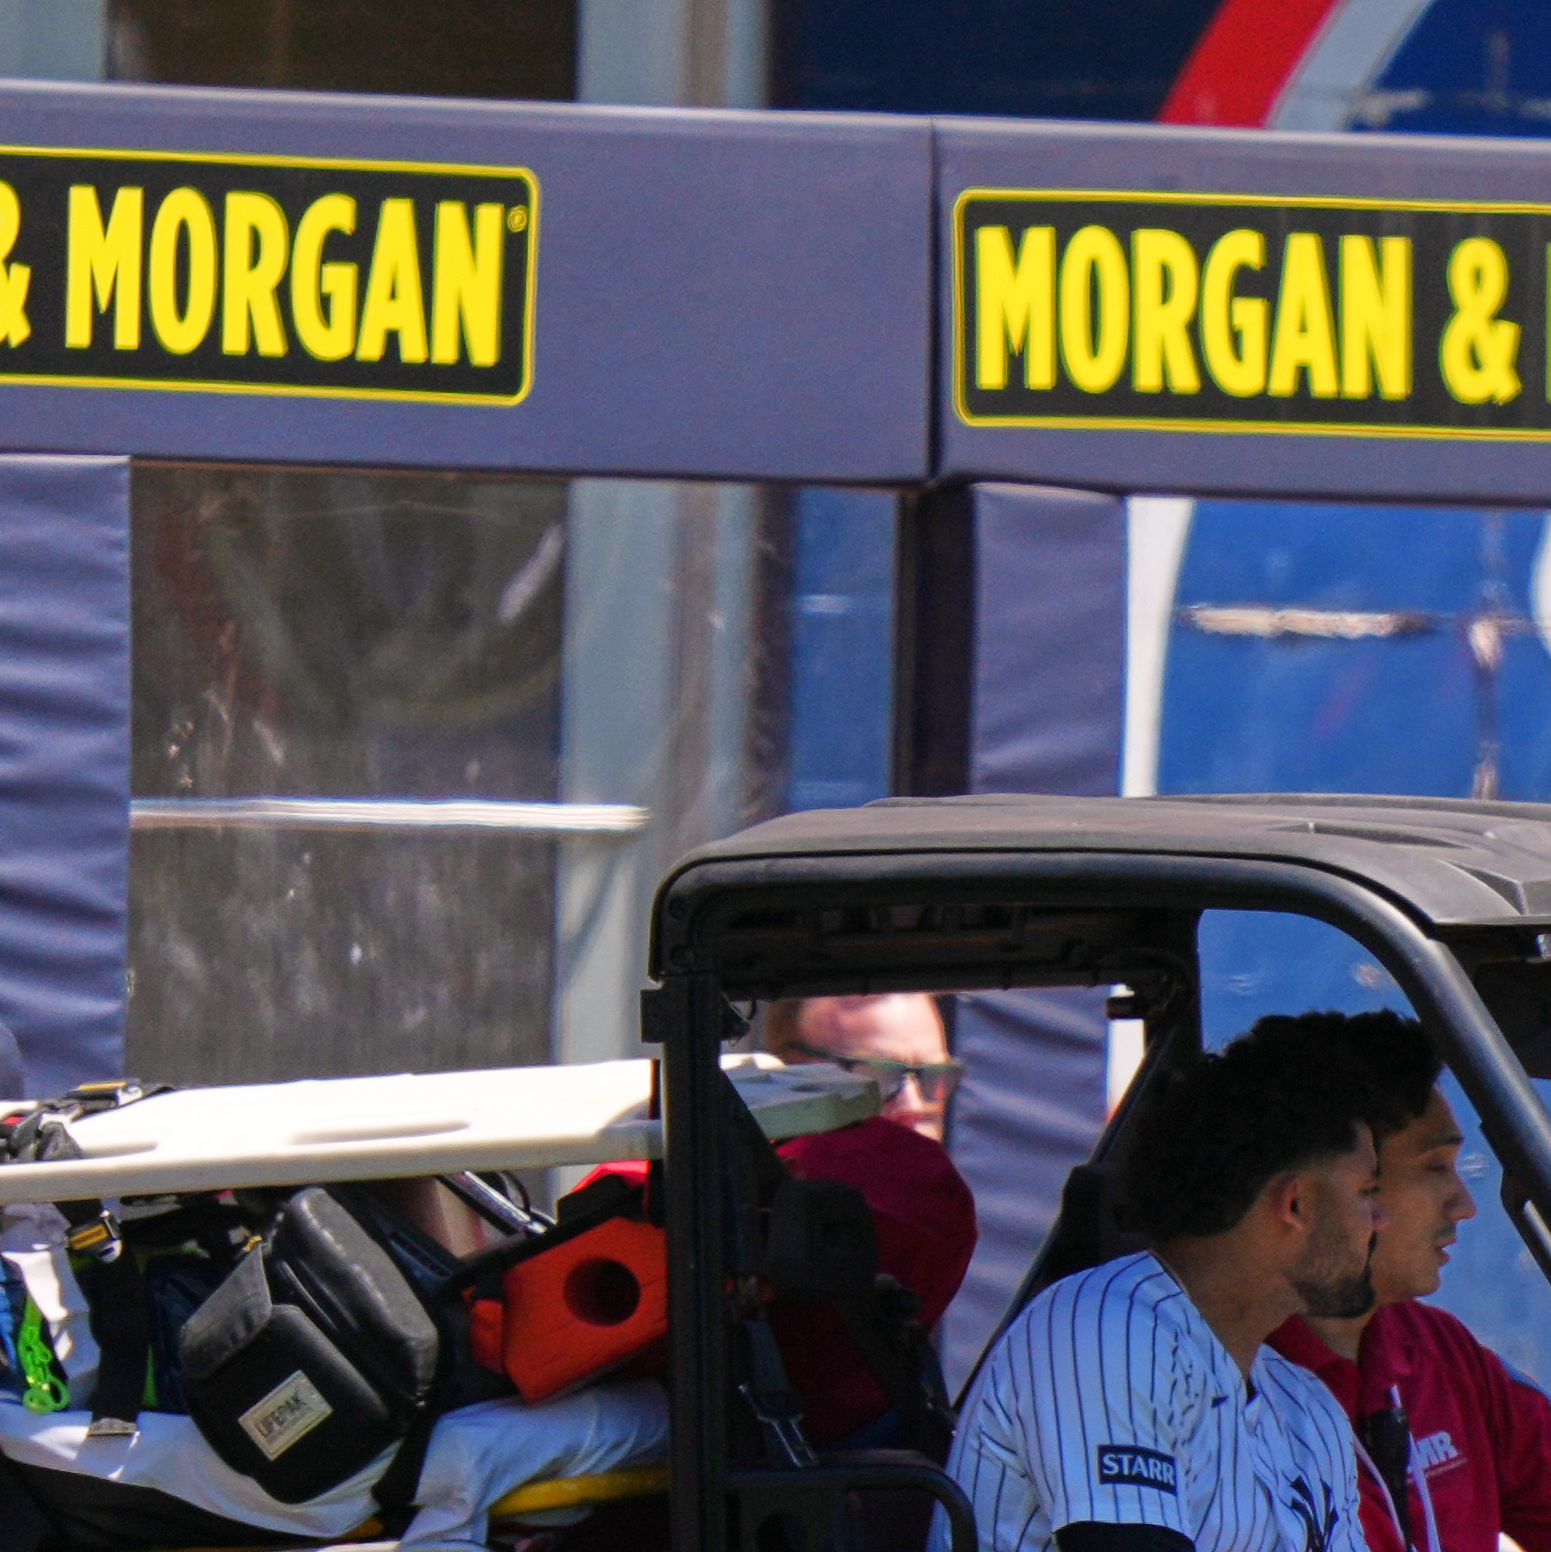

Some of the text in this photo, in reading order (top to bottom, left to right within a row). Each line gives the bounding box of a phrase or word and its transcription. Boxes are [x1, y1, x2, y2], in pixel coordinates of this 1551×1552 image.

[973, 224, 1412, 399] MORGAN
[1440, 236, 1522, 406] &
[1102, 1453, 1176, 1487] STARR
